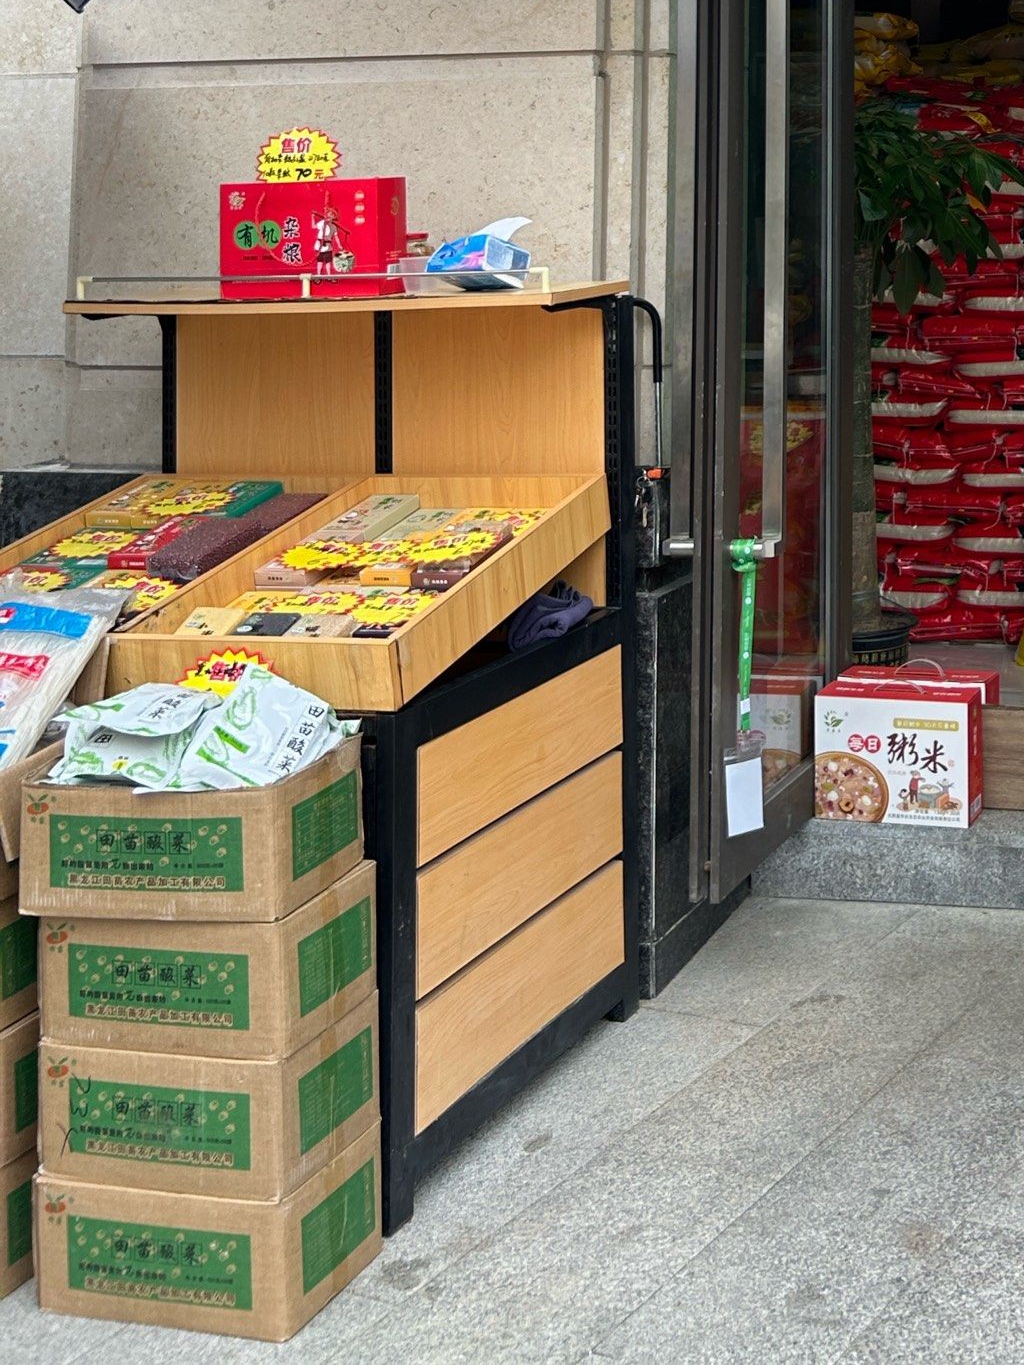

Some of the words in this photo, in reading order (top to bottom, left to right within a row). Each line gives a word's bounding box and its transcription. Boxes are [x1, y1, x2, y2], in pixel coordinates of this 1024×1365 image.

[281, 137, 312, 154] 售价
[295, 169, 312, 181] 70
[314, 169, 325, 180] 元
[237, 224, 279, 248] 有机
[283, 216, 302, 262] 杂粮
[276, 705, 325, 774] 田苗酸菜
[849, 736, 880, 751] 每日
[886, 733, 948, 774] 粥米
[98, 831, 191, 853] 田苗酸菜
[68, 874, 225, 888] 黑龙江田苗农产品加工有限公司
[114, 962, 201, 989] 田苗酸菜
[86, 1004, 234, 1026] 黑龙江田苗农产品加工有限公司
[114, 1098, 201, 1126] 田苗酸菜
[115, 1238, 202, 1265] 田苗酸菜
